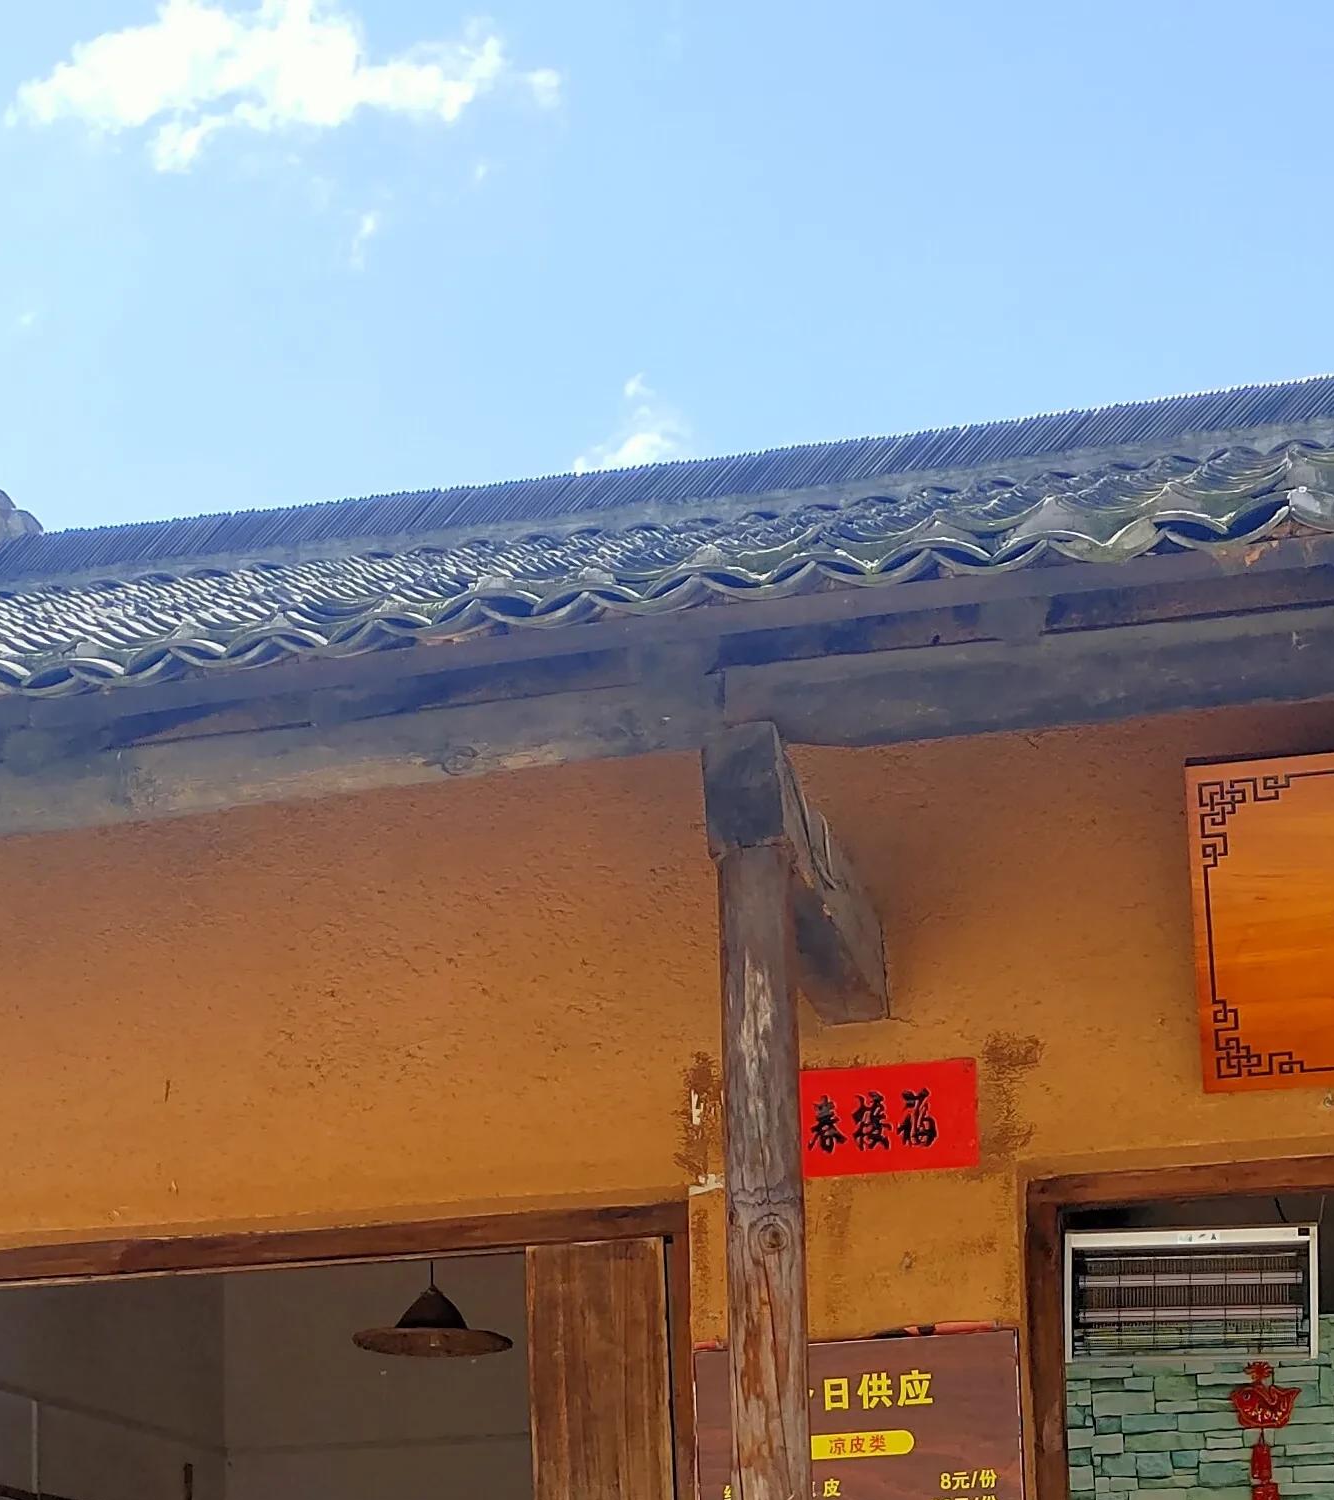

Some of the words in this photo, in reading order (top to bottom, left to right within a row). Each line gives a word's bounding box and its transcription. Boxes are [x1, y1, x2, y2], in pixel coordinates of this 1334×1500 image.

[809, 1370, 934, 1411] 日供应
[829, 1434, 888, 1456] 凉皮类
[939, 1469, 998, 1490] 8元/份
